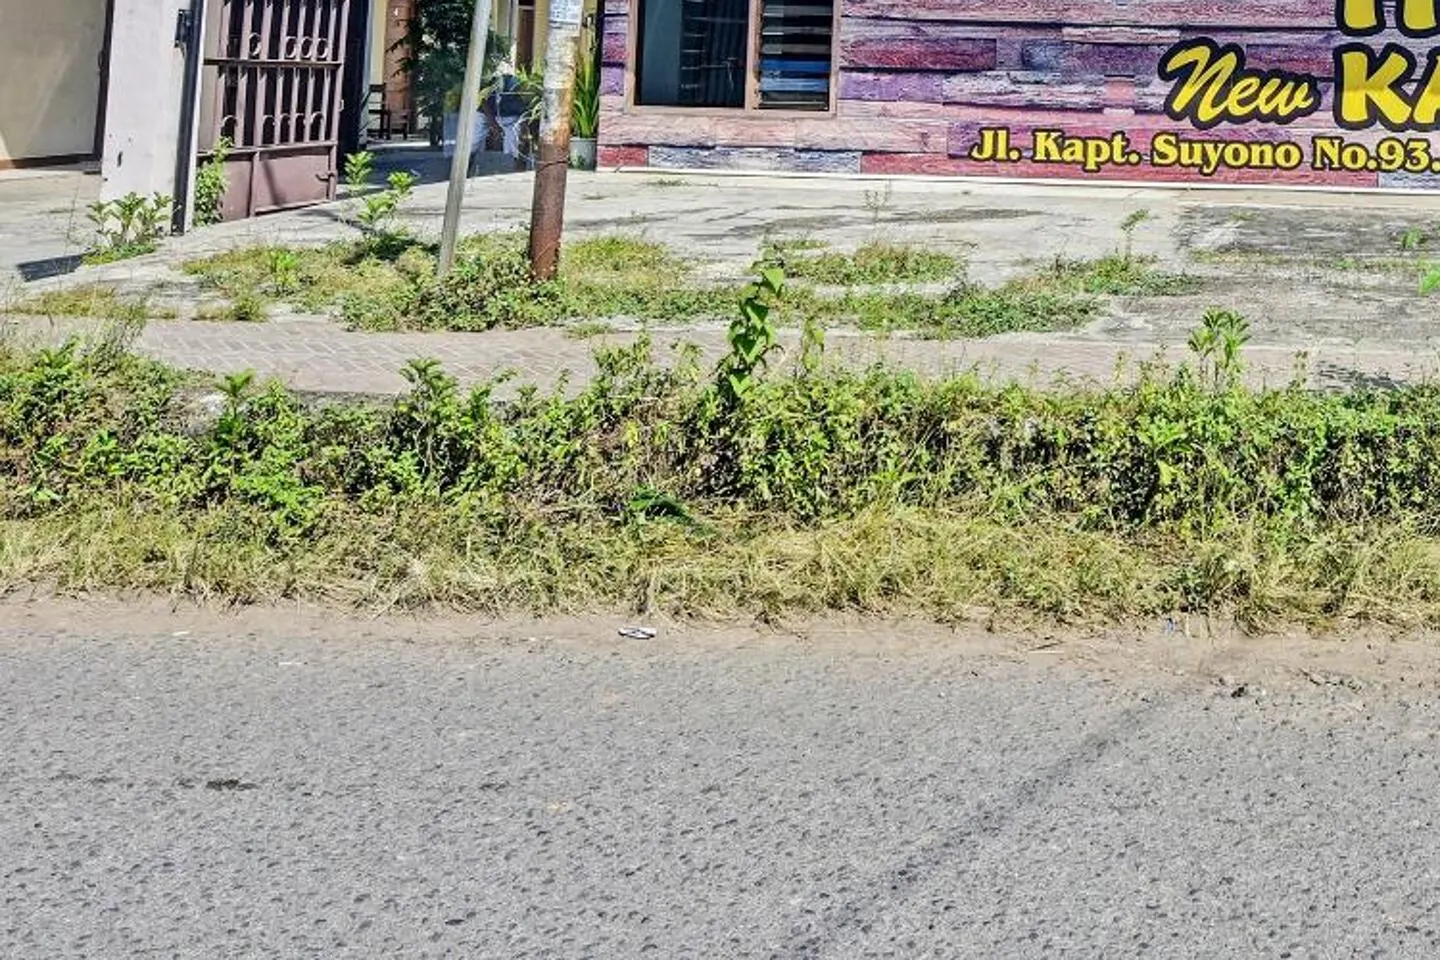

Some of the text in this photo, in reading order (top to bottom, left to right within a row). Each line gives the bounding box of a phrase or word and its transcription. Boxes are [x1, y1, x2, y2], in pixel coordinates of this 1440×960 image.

[1164, 43, 1316, 123] New
[970, 128, 1021, 162] Jl.
[1031, 130, 1141, 172] Kapt.
[1151, 132, 1303, 175] Suyono
